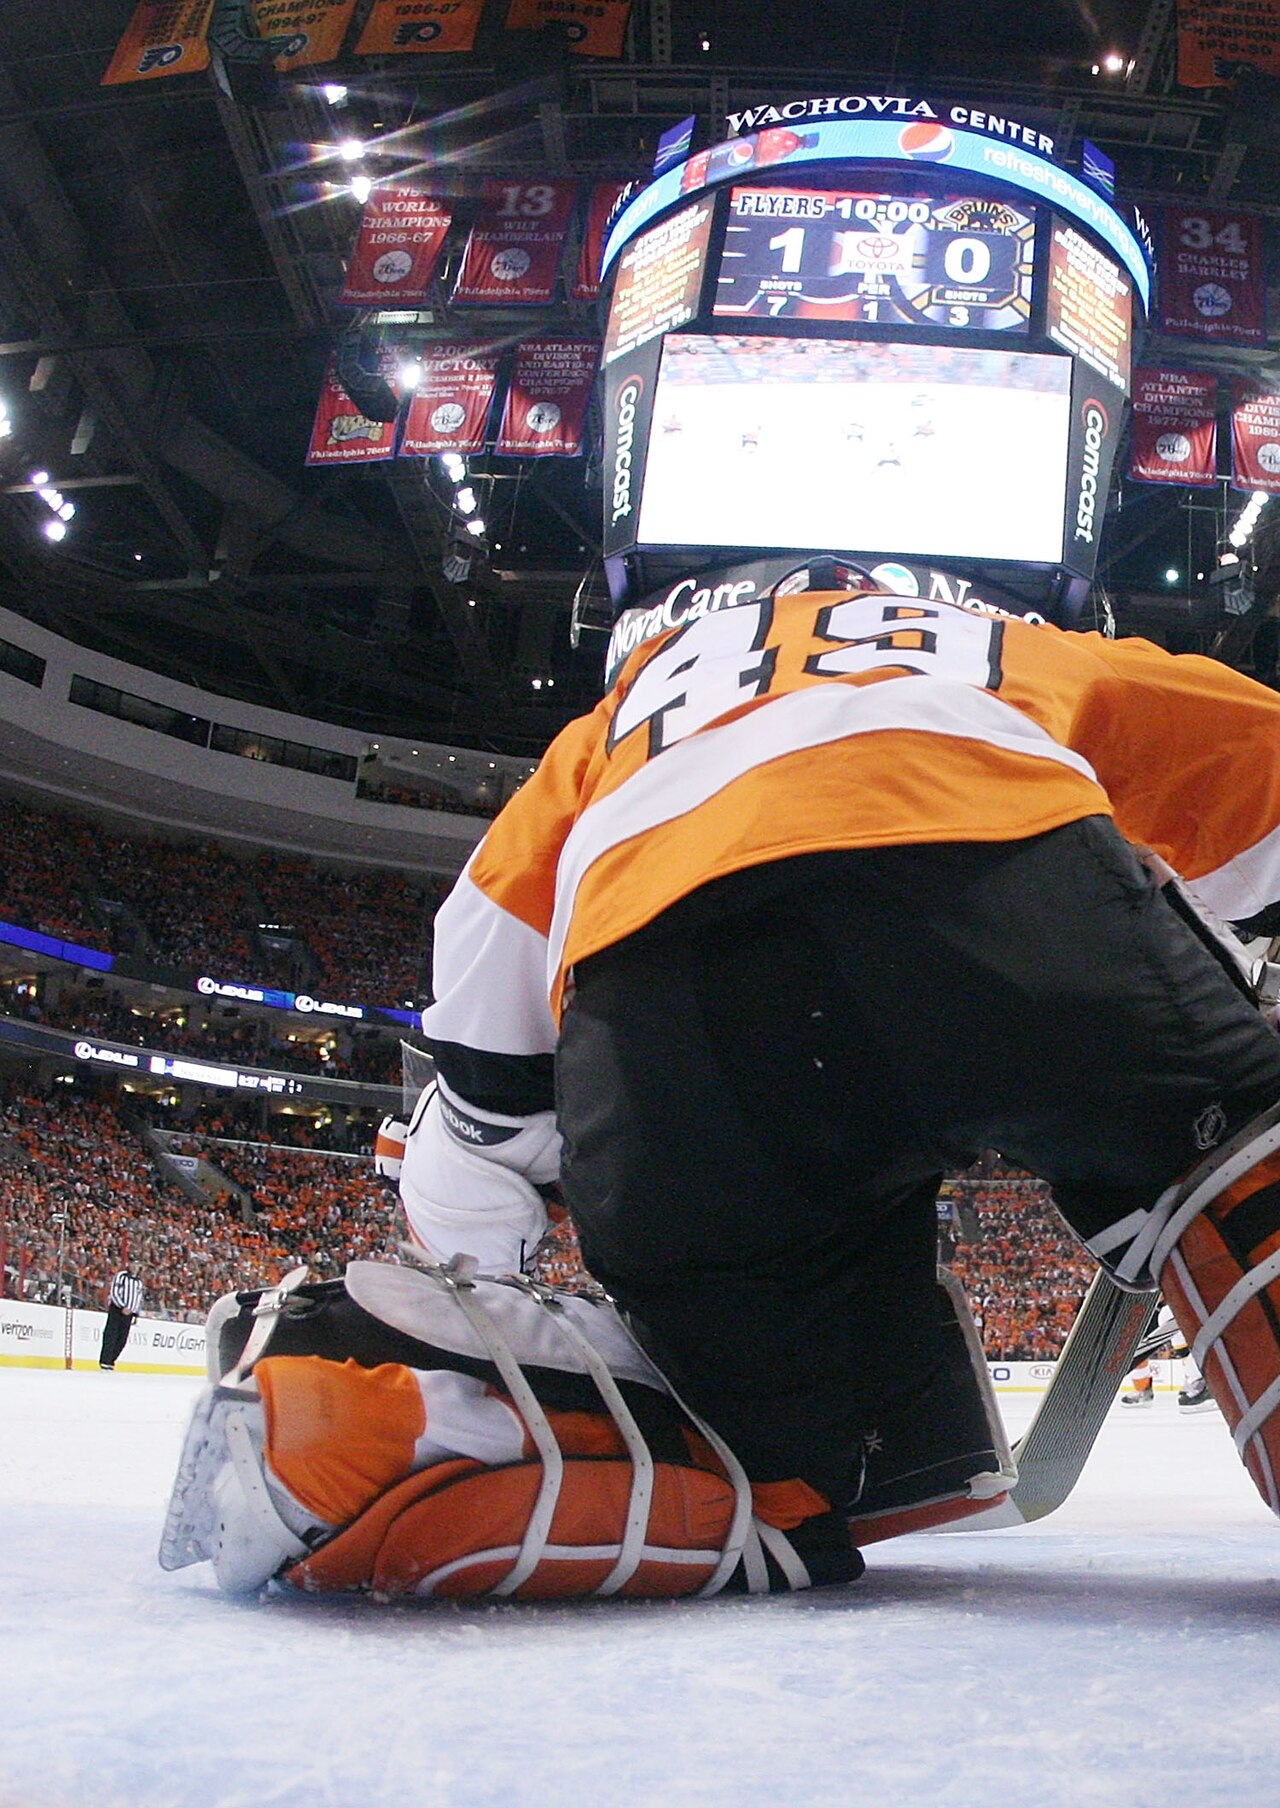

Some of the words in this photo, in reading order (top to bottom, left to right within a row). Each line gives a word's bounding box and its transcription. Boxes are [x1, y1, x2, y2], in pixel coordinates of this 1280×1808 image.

[727, 96, 938, 133] WACHOVIA
[949, 105, 1055, 155] CENTER
[381, 201, 442, 213] WORLD
[498, 185, 556, 218] 13
[736, 195, 825, 216] FLYERS
[836, 199, 931, 223] 10:00
[947, 199, 1016, 227] BRUINS
[362, 215, 453, 229] CHAMPIONS
[368, 231, 434, 244] 1966-67
[1180, 216, 1248, 253] 34
[769, 227, 806, 273] 1
[847, 258, 906, 271] TOYOTA
[944, 237, 992, 285] 0
[1177, 263, 1250, 281] BARKLEY
[759, 279, 803, 292] SHOTS
[857, 281, 892, 295] PER
[943, 289, 989, 303] SHOTS
[766, 296, 788, 317] 7
[862, 300, 879, 321] 1
[948, 306, 971, 327] 3
[532, 351, 582, 360] DIVISION
[422, 359, 498, 372] VICTORY
[1159, 373, 1189, 385] NBA
[1140, 383, 1209, 397] ATLANTIC
[1144, 392, 1204, 406] DIVISION
[1132, 402, 1215, 418] CHAMPIONS
[605, 578, 757, 684] NovaCare
[214, 983, 264, 1002] LEXUS
[313, 1001, 363, 1019] LEXUS
[92, 1049, 138, 1067] LEXUS
[1, 1320, 34, 1340] verizon
[152, 1332, 175, 1349] BUD
[179, 1336, 206, 1351] LIGHT
